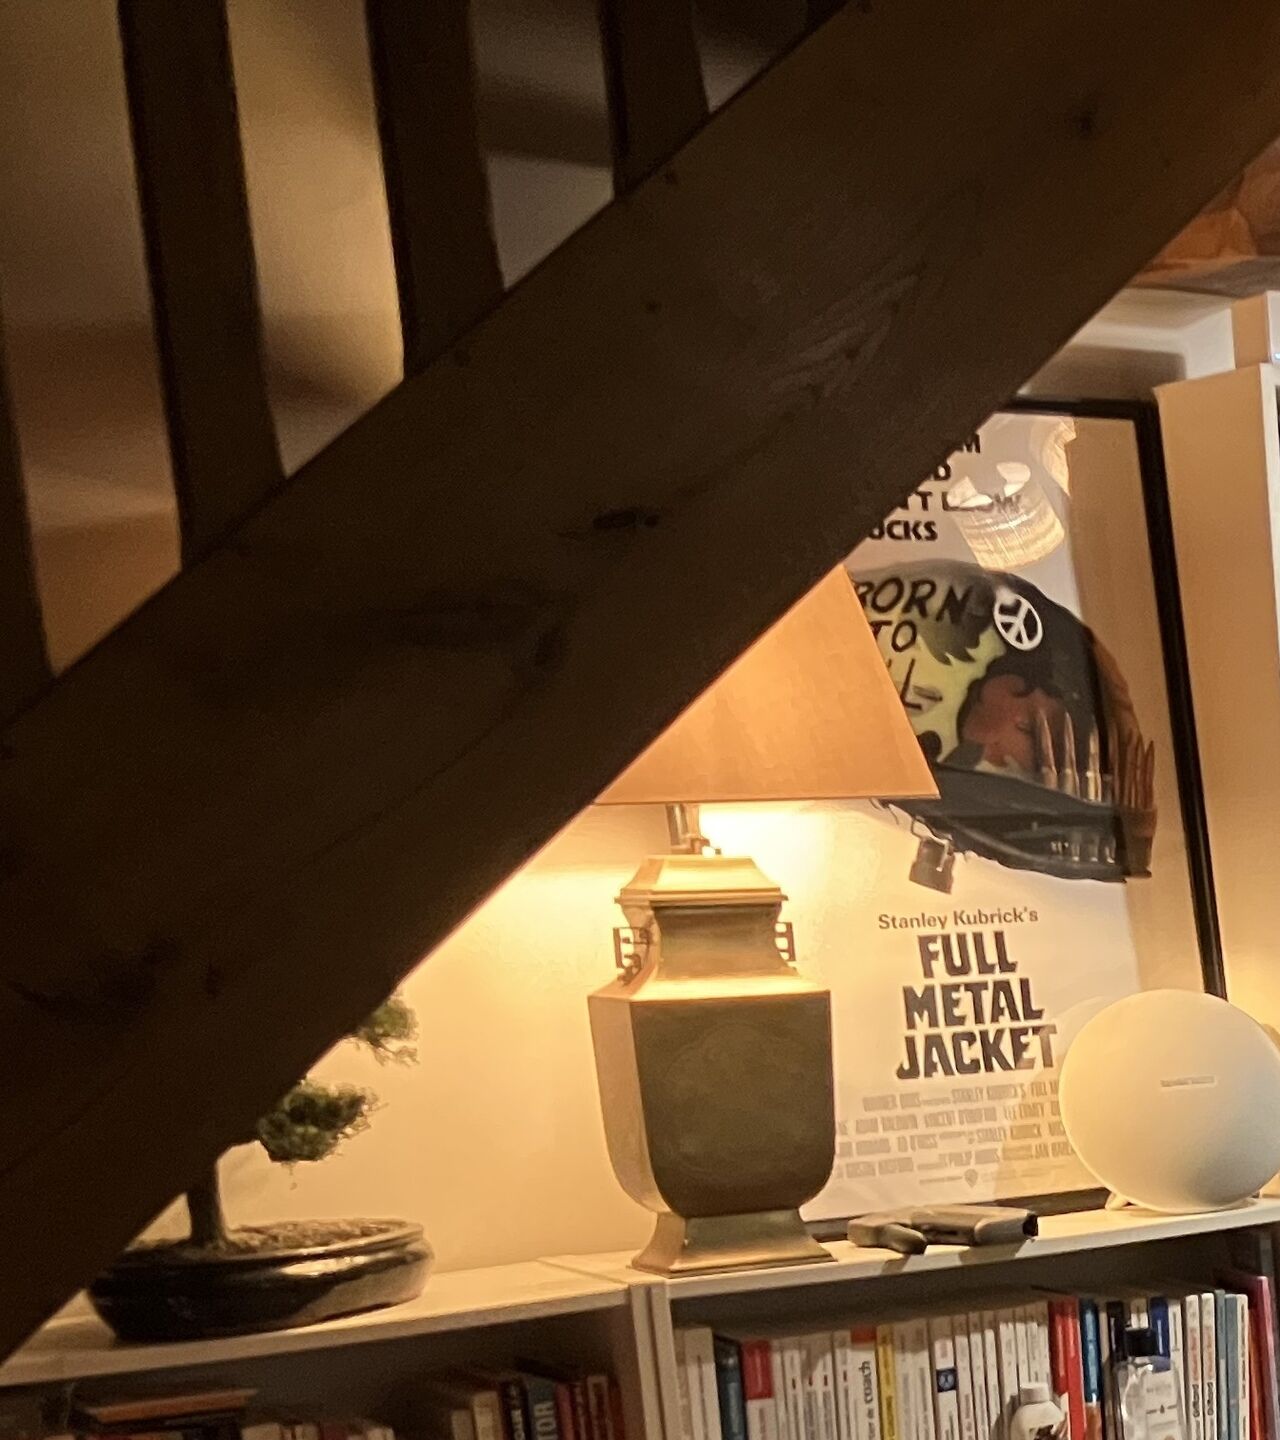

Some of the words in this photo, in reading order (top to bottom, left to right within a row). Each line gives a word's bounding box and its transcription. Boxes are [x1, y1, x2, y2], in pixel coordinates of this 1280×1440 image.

[878, 912, 948, 931] Stanley
[952, 906, 1039, 928] Kubrick's
[917, 931, 1018, 979] FULL
[901, 977, 1045, 1030] METAL
[895, 1024, 1058, 1080] JACKET
